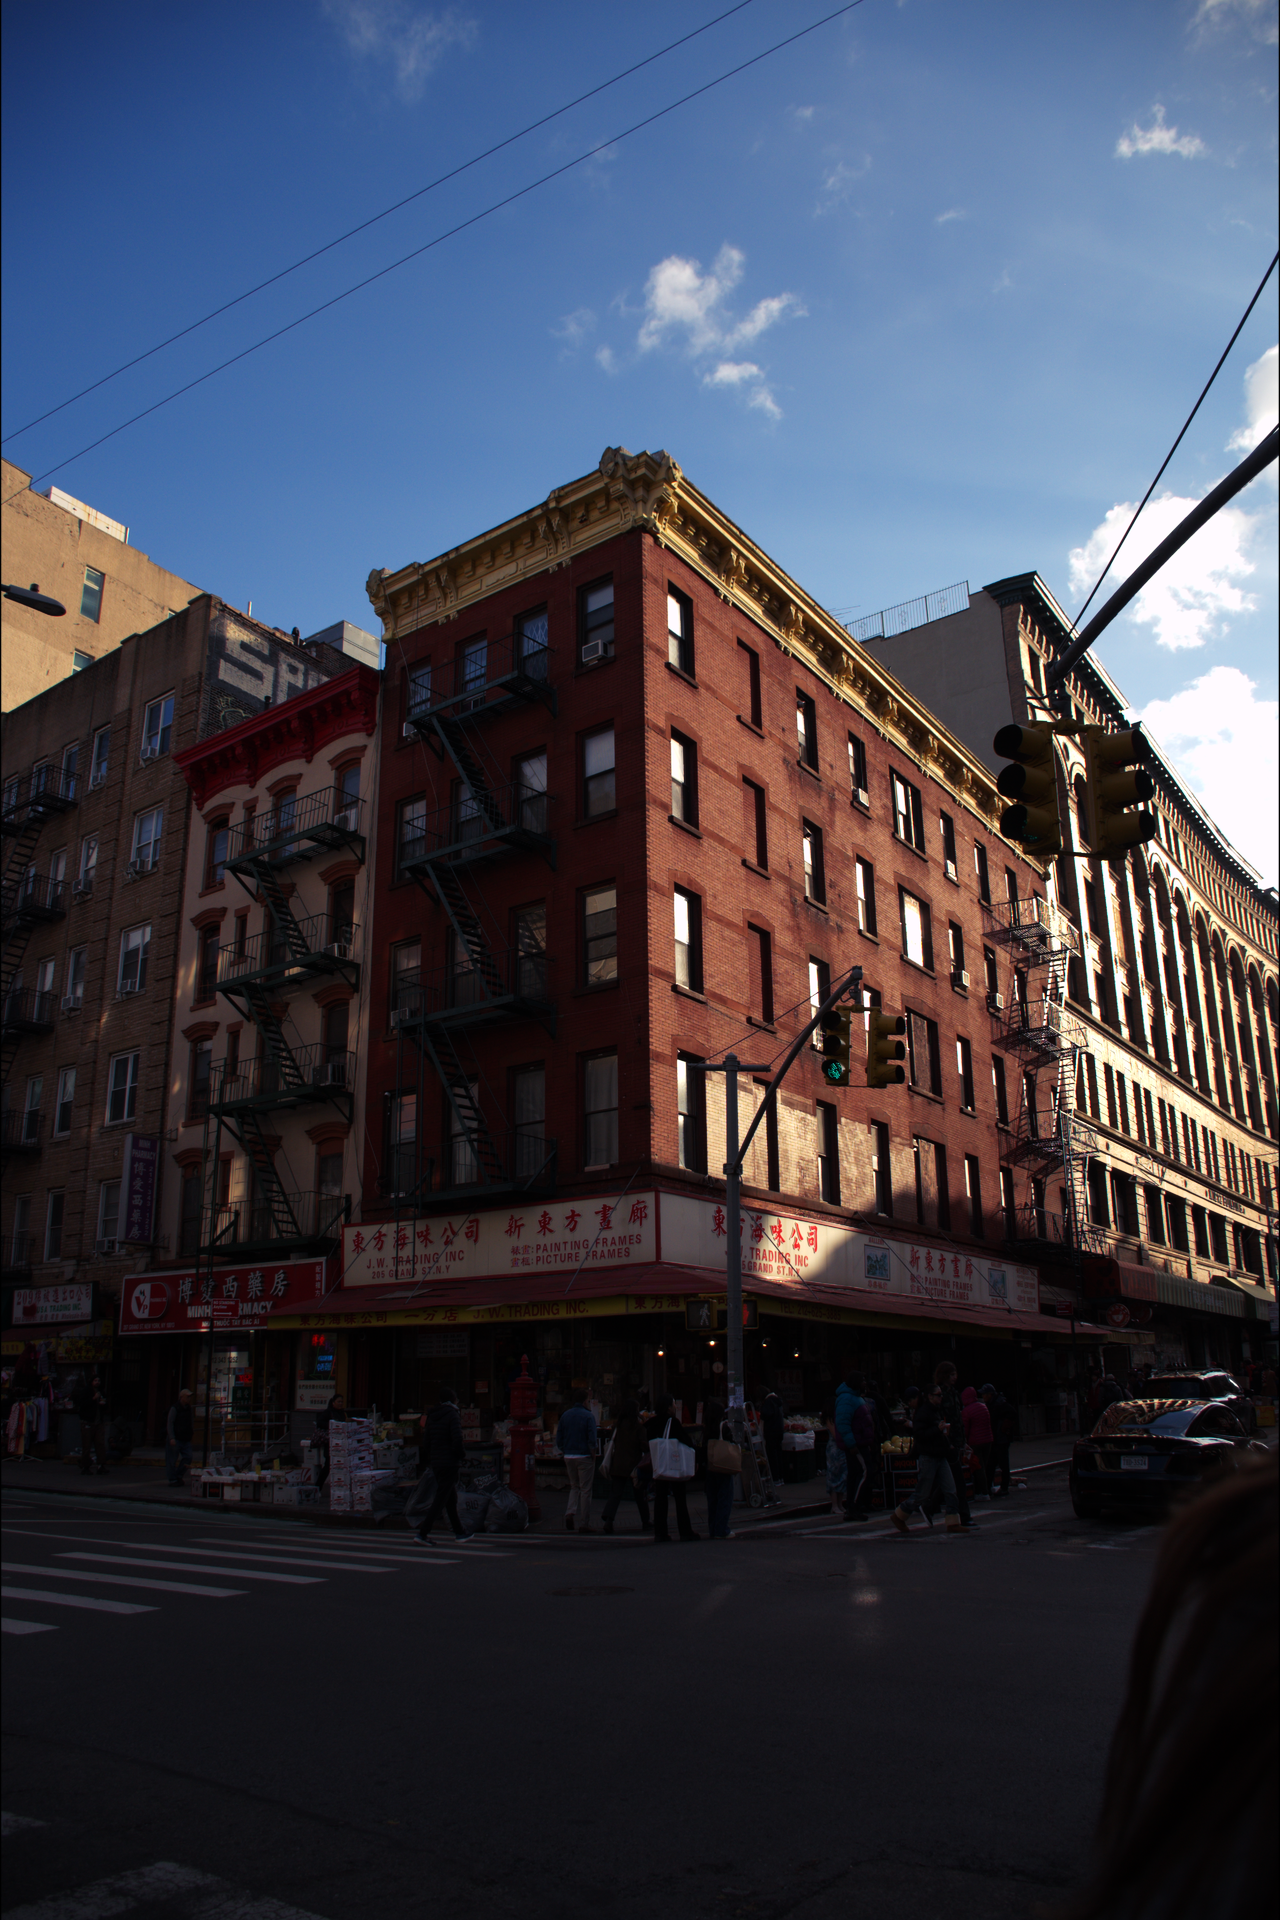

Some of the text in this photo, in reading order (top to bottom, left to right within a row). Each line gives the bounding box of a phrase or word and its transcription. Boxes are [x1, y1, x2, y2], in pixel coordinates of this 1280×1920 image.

[138, 1139, 151, 1148] MINH
[132, 1149, 156, 1160] PHARMACY
[352, 1218, 479, 1254] 東方海味公司
[535, 1239, 589, 1253] PAINTING
[595, 1233, 642, 1247] FRAMES
[392, 1252, 439, 1267] TRADING
[445, 1250, 464, 1262] INC
[535, 1251, 580, 1265] PICTURE
[586, 1247, 630, 1259] FRAMES
[750, 1247, 790, 1264] TRADING
[794, 1254, 809, 1267] INC
[372, 1270, 385, 1279] 205
[389, 1267, 417, 1278] GRAND
[747, 1261, 773, 1274] GRAND
[925, 1276, 950, 1289] PAINTING
[952, 1281, 973, 1292] FRAMES
[925, 1286, 947, 1298] PICTURE
[949, 1290, 969, 1301] FRAMES
[49, 1304, 71, 1313] TRADING
[187, 1304, 211, 1318] MINH
[299, 1311, 388, 1327] 東方海味公司
[507, 1303, 559, 1317] TRADING
[566, 1301, 589, 1314] INC.
[779, 1301, 841, 1321] TEL: 212-625-3885
[893, 1459, 916, 1469] noble
